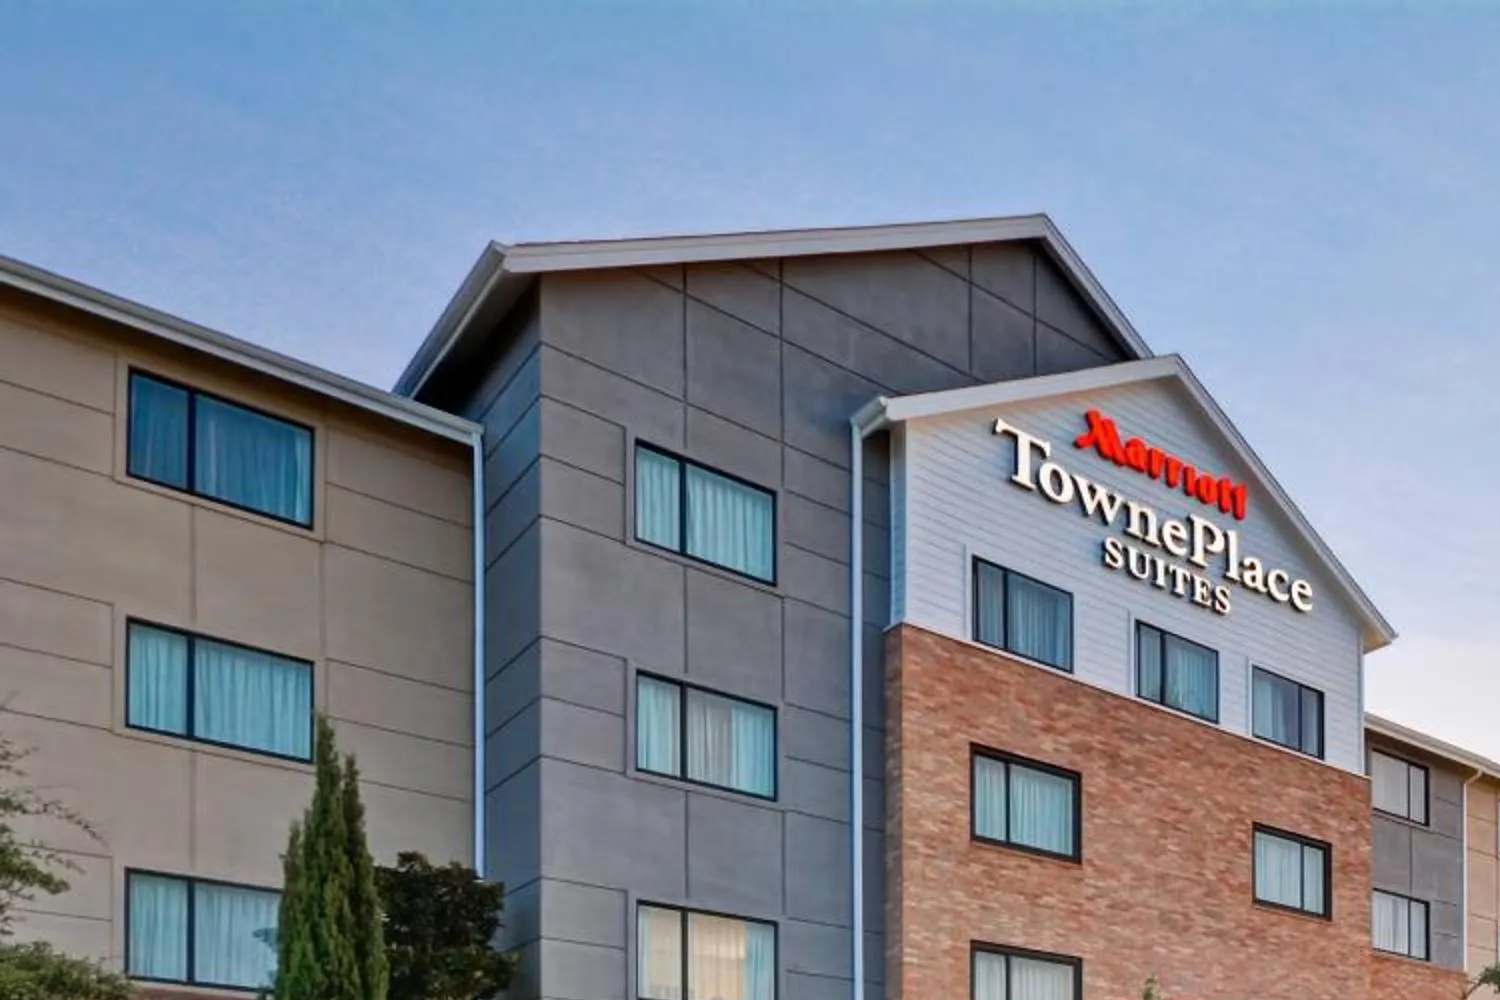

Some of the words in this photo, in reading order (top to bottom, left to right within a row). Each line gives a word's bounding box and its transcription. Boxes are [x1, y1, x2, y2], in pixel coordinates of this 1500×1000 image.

[993, 417, 1313, 612] TownePlace
[1074, 409, 1247, 521] Marriott
[1103, 536, 1231, 614] SUITES
